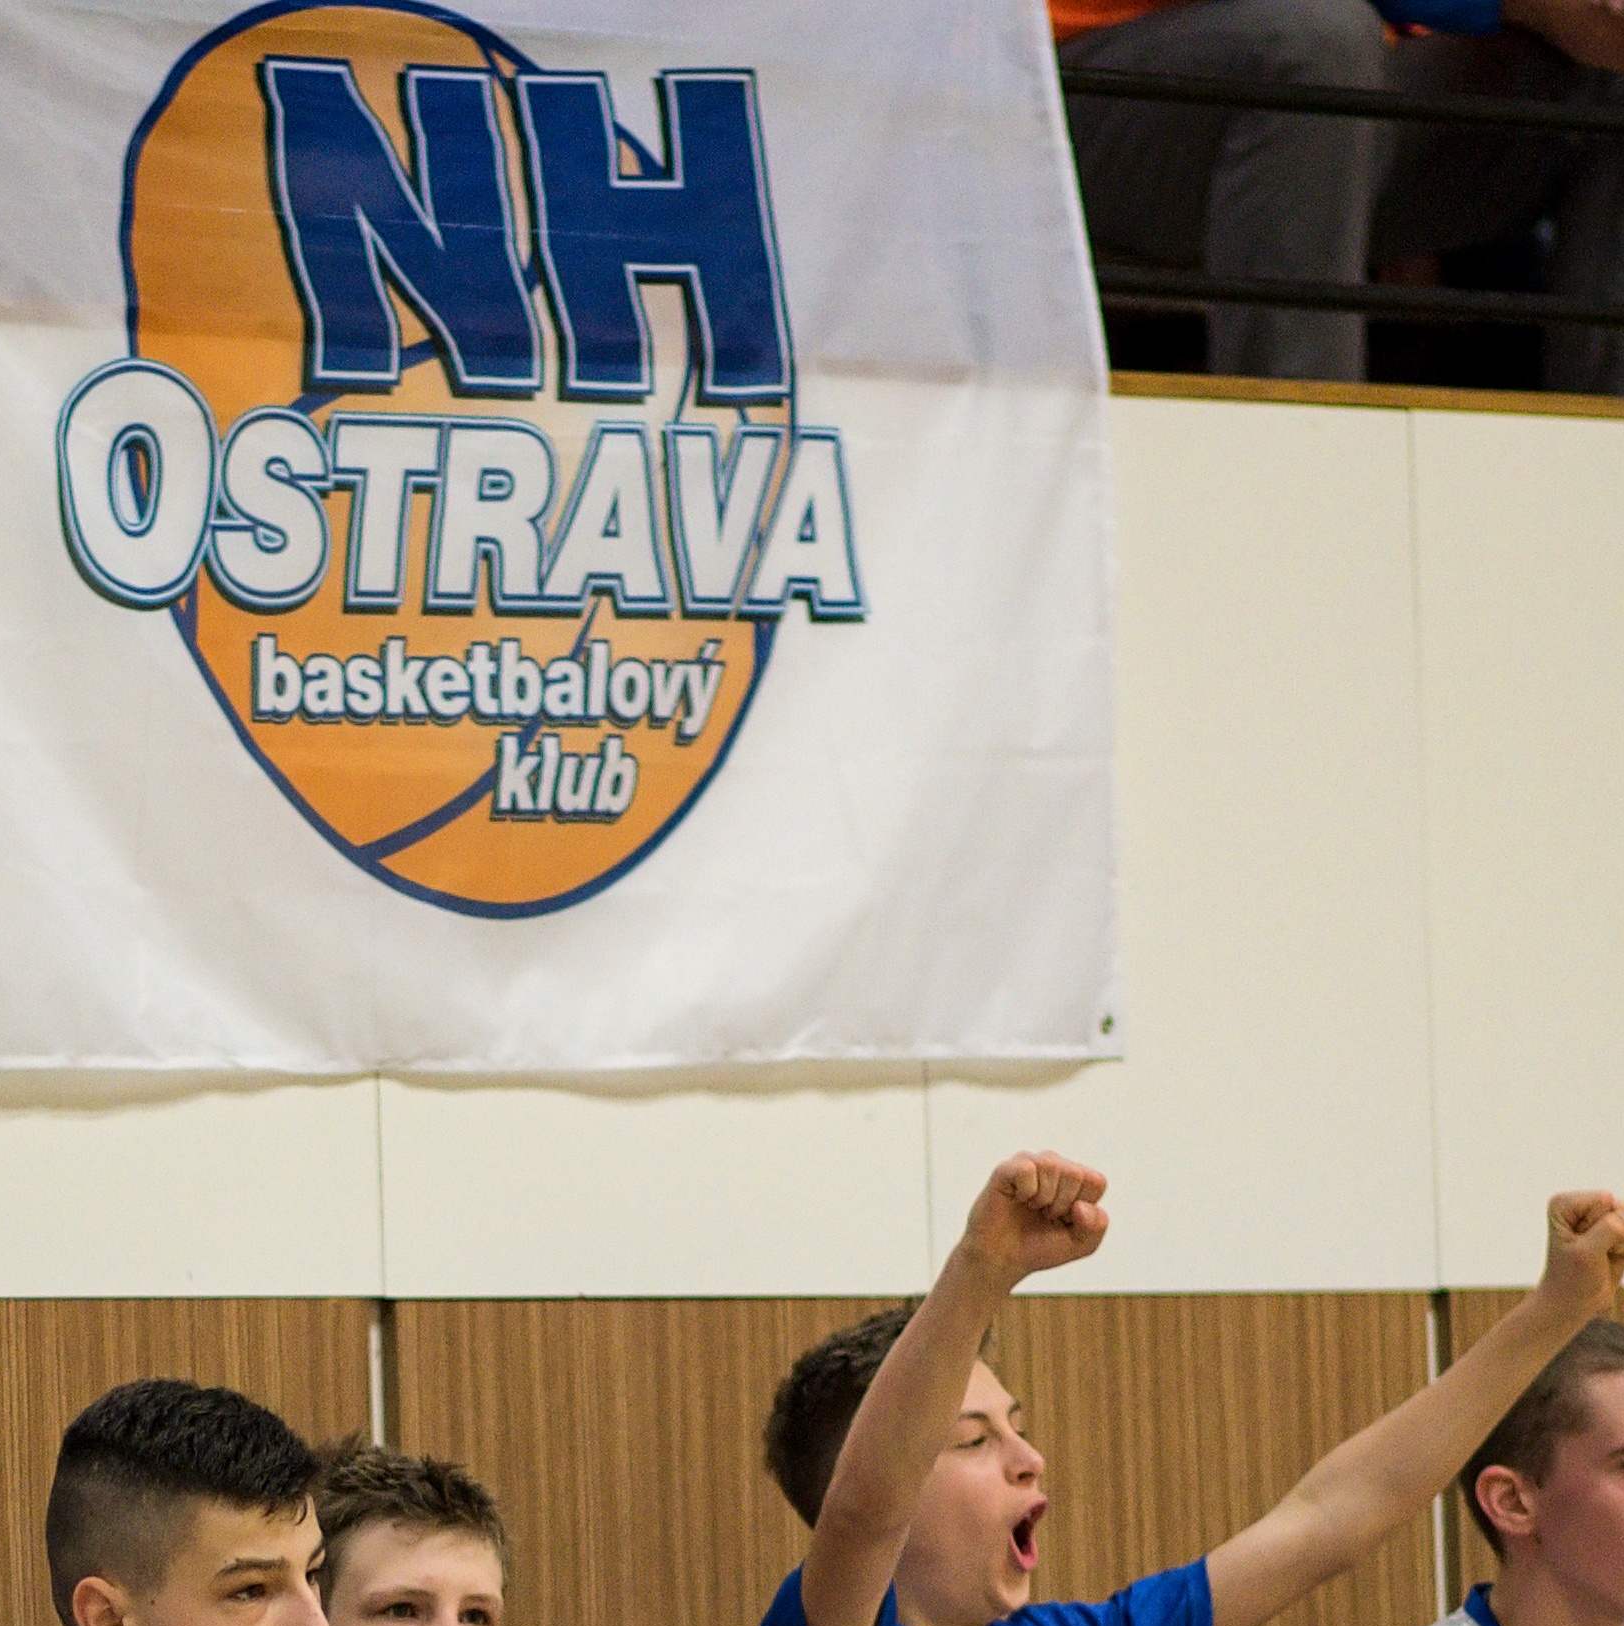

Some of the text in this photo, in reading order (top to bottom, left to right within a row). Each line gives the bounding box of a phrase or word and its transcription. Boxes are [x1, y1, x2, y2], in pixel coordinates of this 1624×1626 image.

[261, 55, 793, 400] NH
[57, 356, 869, 620] OSTRAVA
[252, 633, 726, 745] basketbalový
[491, 732, 639, 824] klub
